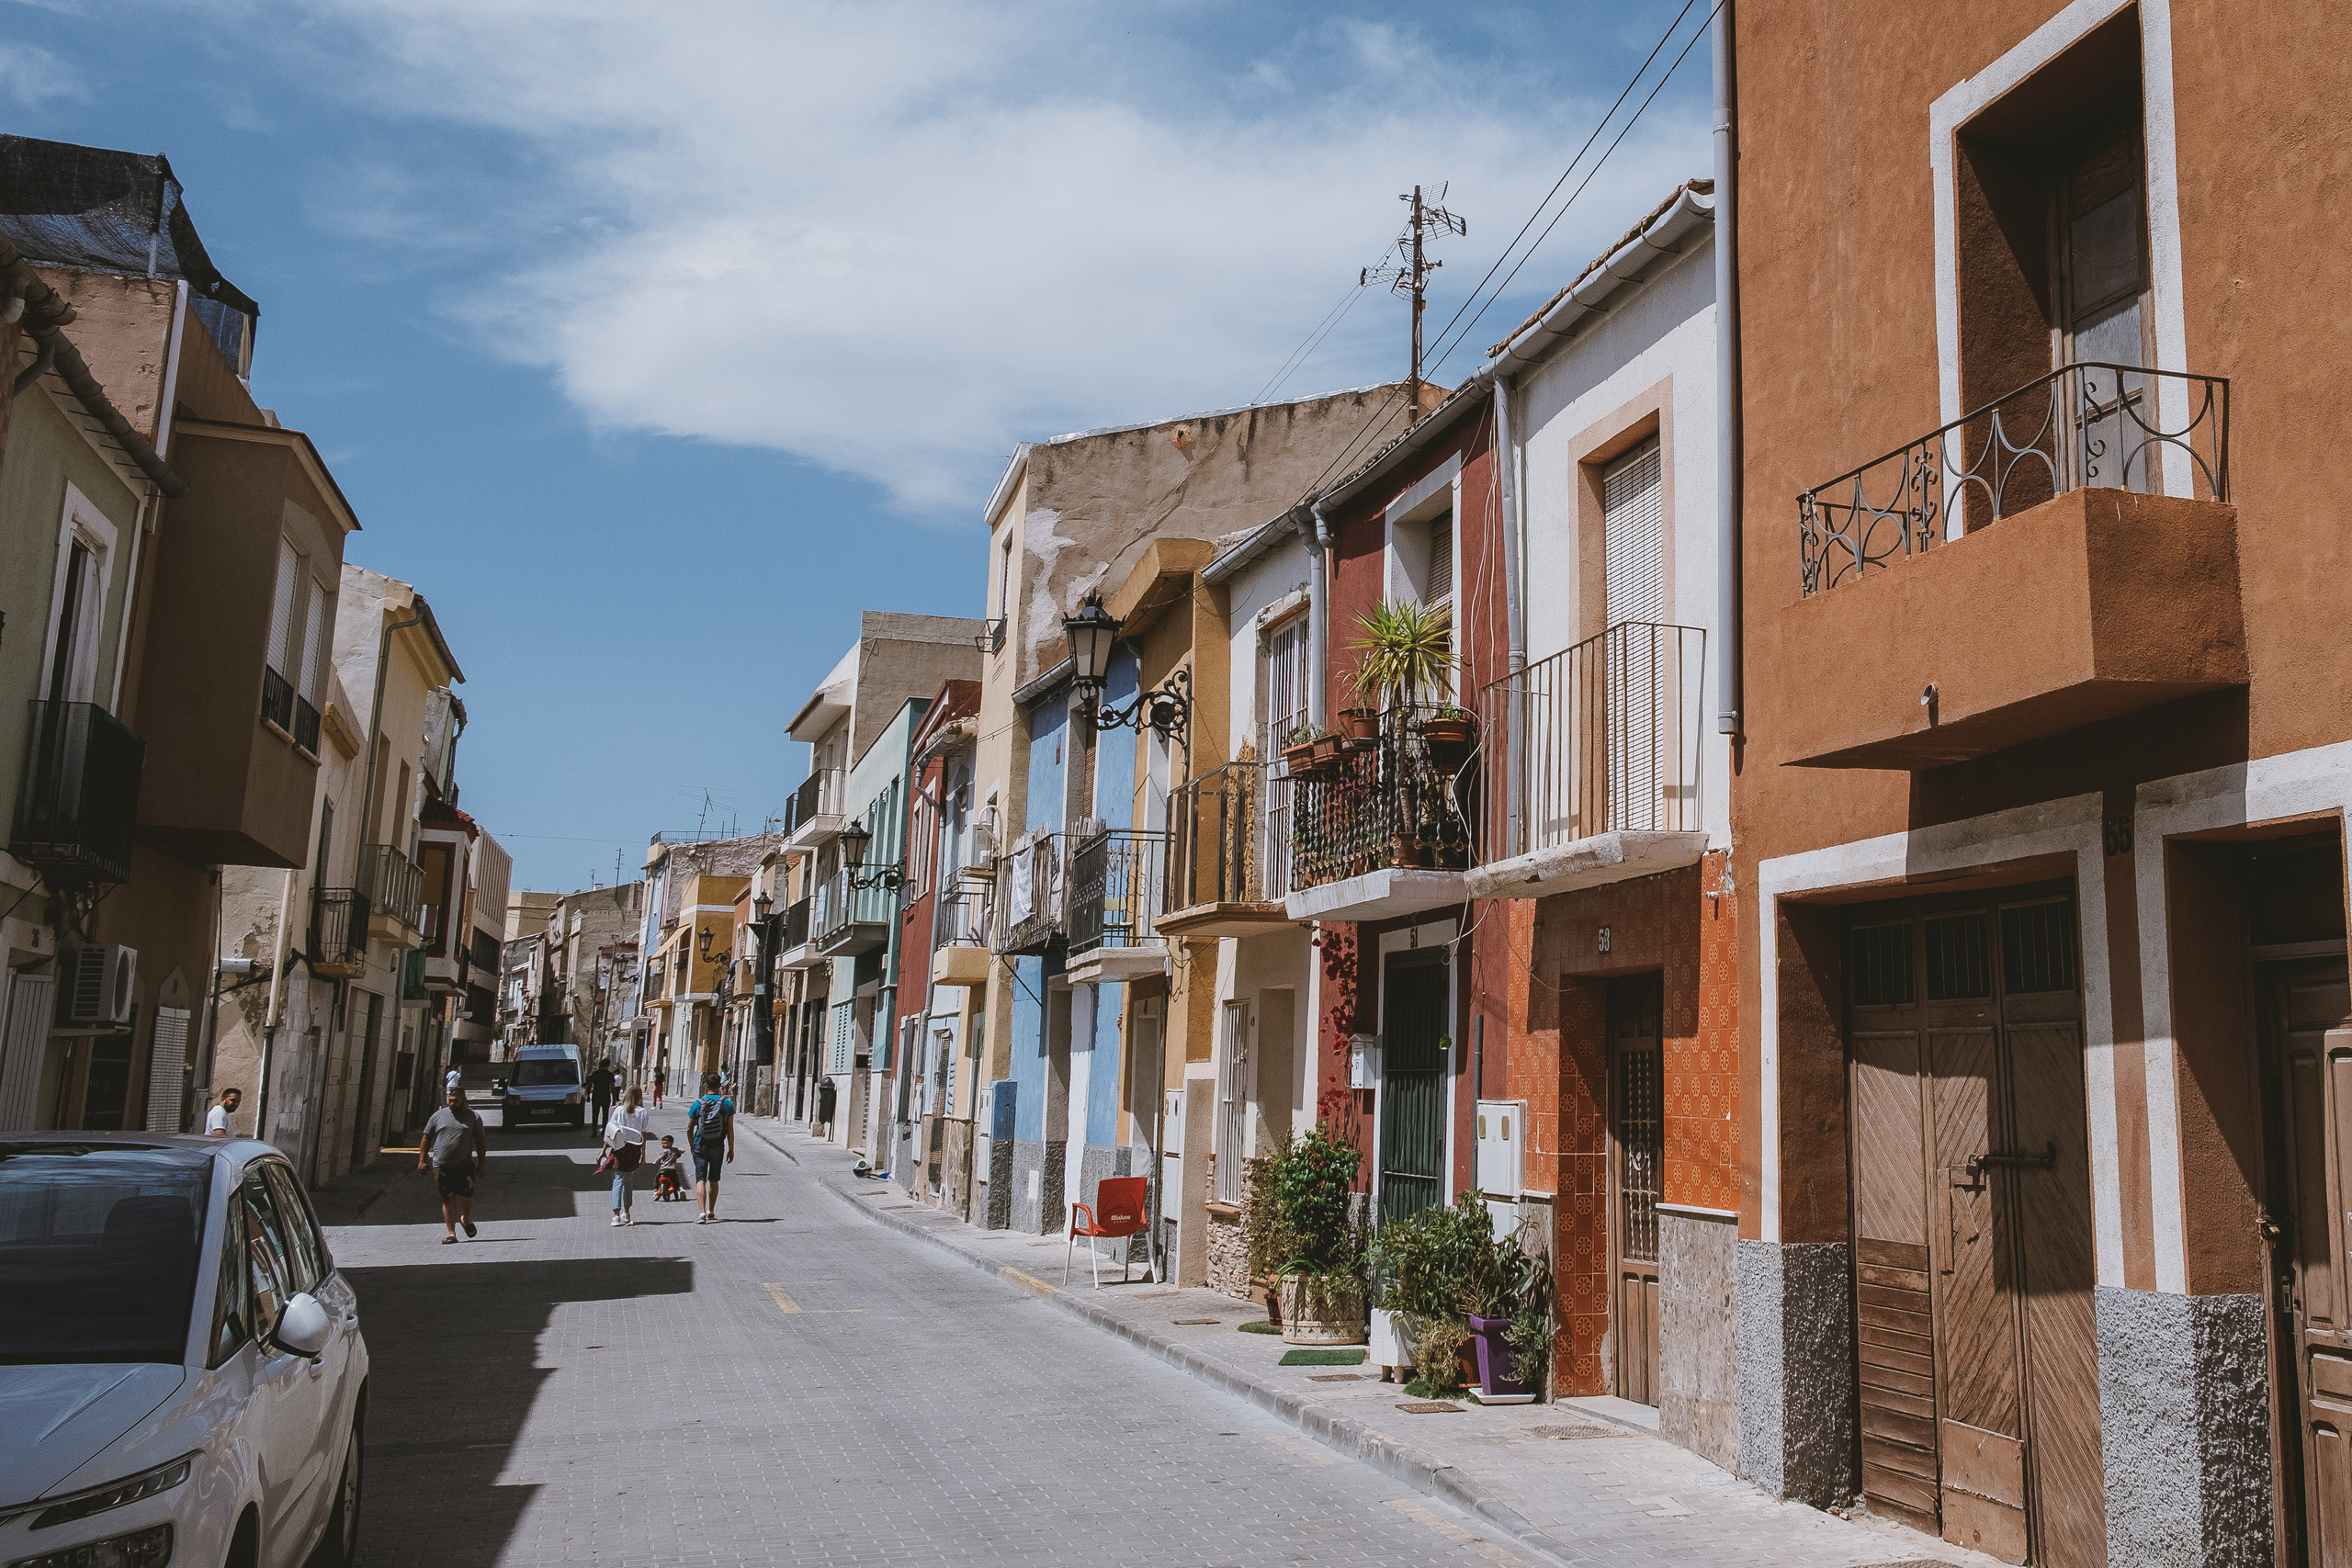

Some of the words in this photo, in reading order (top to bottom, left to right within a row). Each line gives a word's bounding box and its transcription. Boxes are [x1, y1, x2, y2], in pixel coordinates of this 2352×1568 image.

[2104, 815, 2132, 856] 55
[1410, 927, 1419, 949] 51
[1599, 928, 1610, 952] 53
